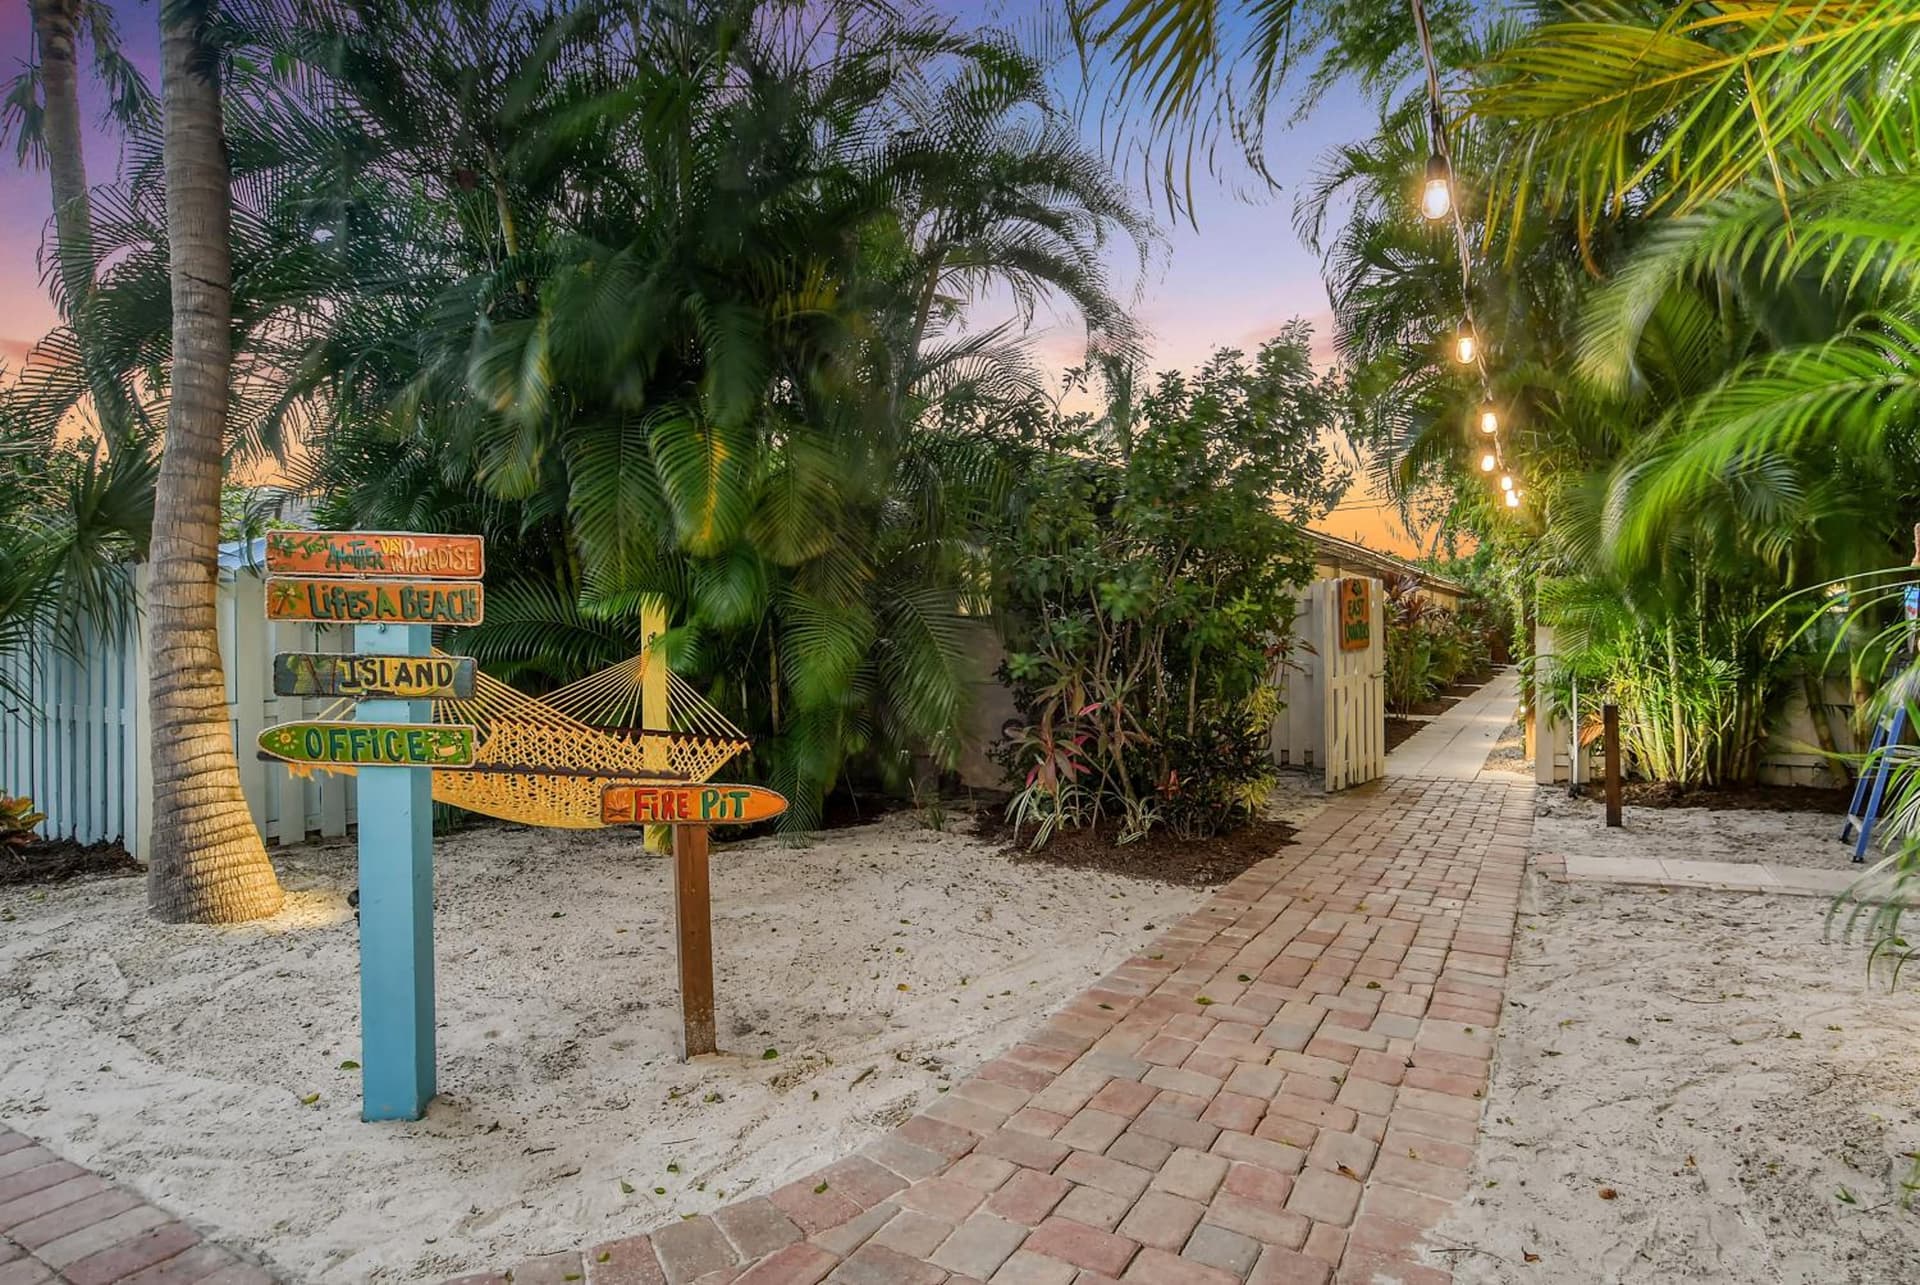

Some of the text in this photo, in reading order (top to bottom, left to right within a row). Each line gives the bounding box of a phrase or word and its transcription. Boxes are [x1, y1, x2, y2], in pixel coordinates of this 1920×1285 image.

[379, 535, 404, 557] DAY
[376, 586, 398, 618] A
[399, 585, 478, 622] BEACH
[1347, 598, 1364, 619] EAST
[340, 655, 453, 689] ISLAND
